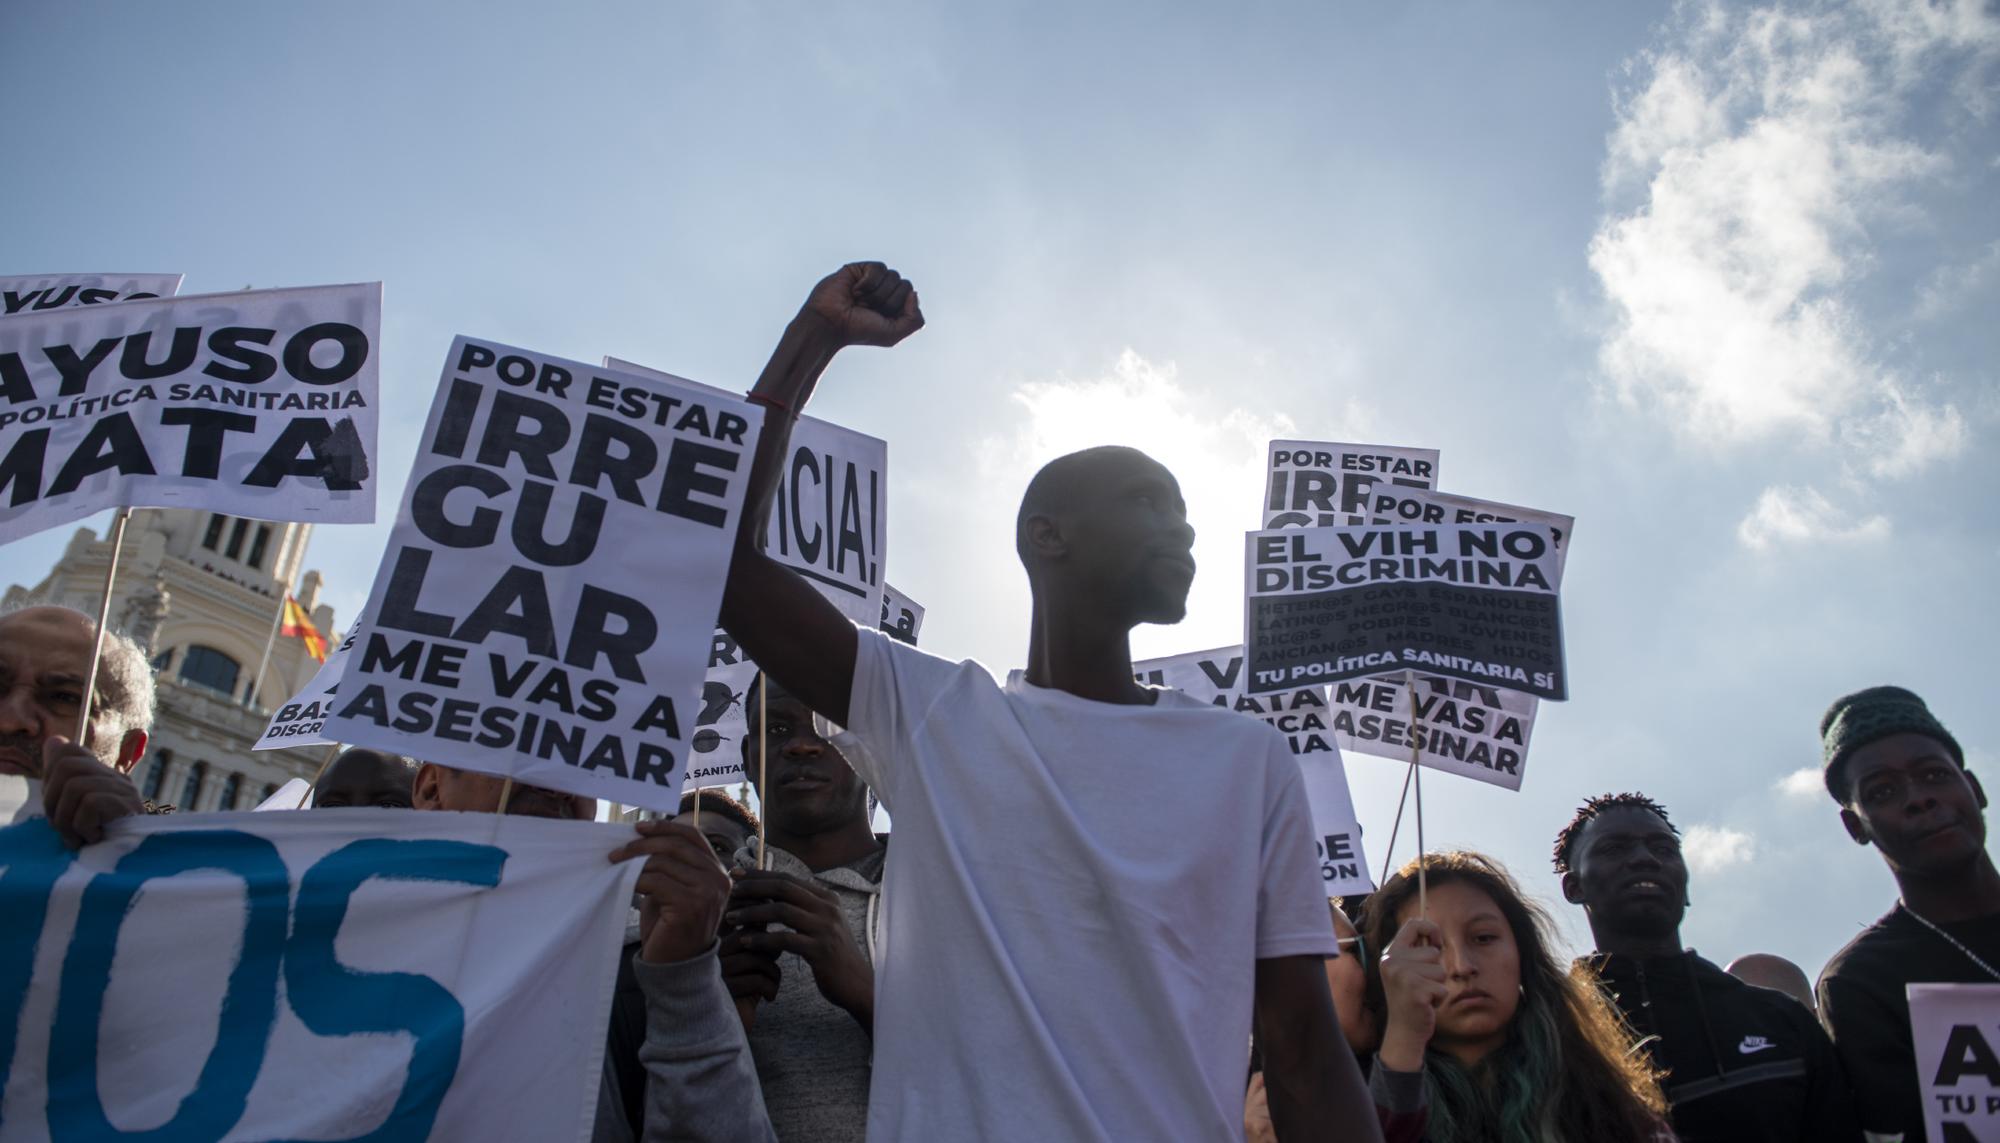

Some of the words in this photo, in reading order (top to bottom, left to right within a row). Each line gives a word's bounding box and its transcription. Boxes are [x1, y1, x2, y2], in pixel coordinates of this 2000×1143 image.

[169, 383, 367, 411] SANITARIA
[457, 343, 573, 398] POR
[586, 376, 749, 446] ESTAR
[431, 378, 741, 529] IRRE
[1273, 450, 1333, 468] POR
[1341, 453, 1433, 478] ESTAR
[1269, 470, 1430, 513] IRR
[411, 464, 608, 567] GU
[1374, 495, 1445, 525] POR
[1257, 535, 1322, 565] EL
[1337, 530, 1439, 560] VIH
[1458, 530, 1547, 561] NO
[1256, 557, 1553, 593] DISCRIMINA
[375, 545, 658, 685] LAR
[1257, 595, 1352, 616] HETER@S
[1364, 587, 1418, 602] GAYS
[1430, 587, 1551, 614] ESPAÑOLES
[1257, 610, 1347, 632] LATIN@S
[1354, 601, 1441, 618] NEGR@S
[1448, 605, 1553, 631] BLANC@S
[1256, 635, 1369, 663] ANCIAN@S
[1386, 630, 1475, 653] MADRES
[1494, 645, 1555, 667] HIJOS
[1257, 628, 1322, 648] RIC@S
[1348, 616, 1432, 634] POBRES
[1457, 622, 1553, 649] JÓVENES
[358, 632, 468, 689] ME
[489, 651, 620, 722] VAS
[633, 695, 682, 741] A
[1256, 668, 1285, 685] TU
[1292, 650, 1398, 680] POLÍTICA
[1402, 648, 1530, 684] SANITARIA
[1533, 670, 1556, 691] SÍ
[266, 722, 323, 739] DISCR
[1335, 682, 1397, 713] ME
[1414, 691, 1487, 734] VAS
[1494, 716, 1523, 746] A
[337, 683, 676, 788] ASESINAR
[1333, 710, 1520, 776] ASESINAR
[694, 763, 744, 779] SANITA
[1936, 1094, 1976, 1115] TU
